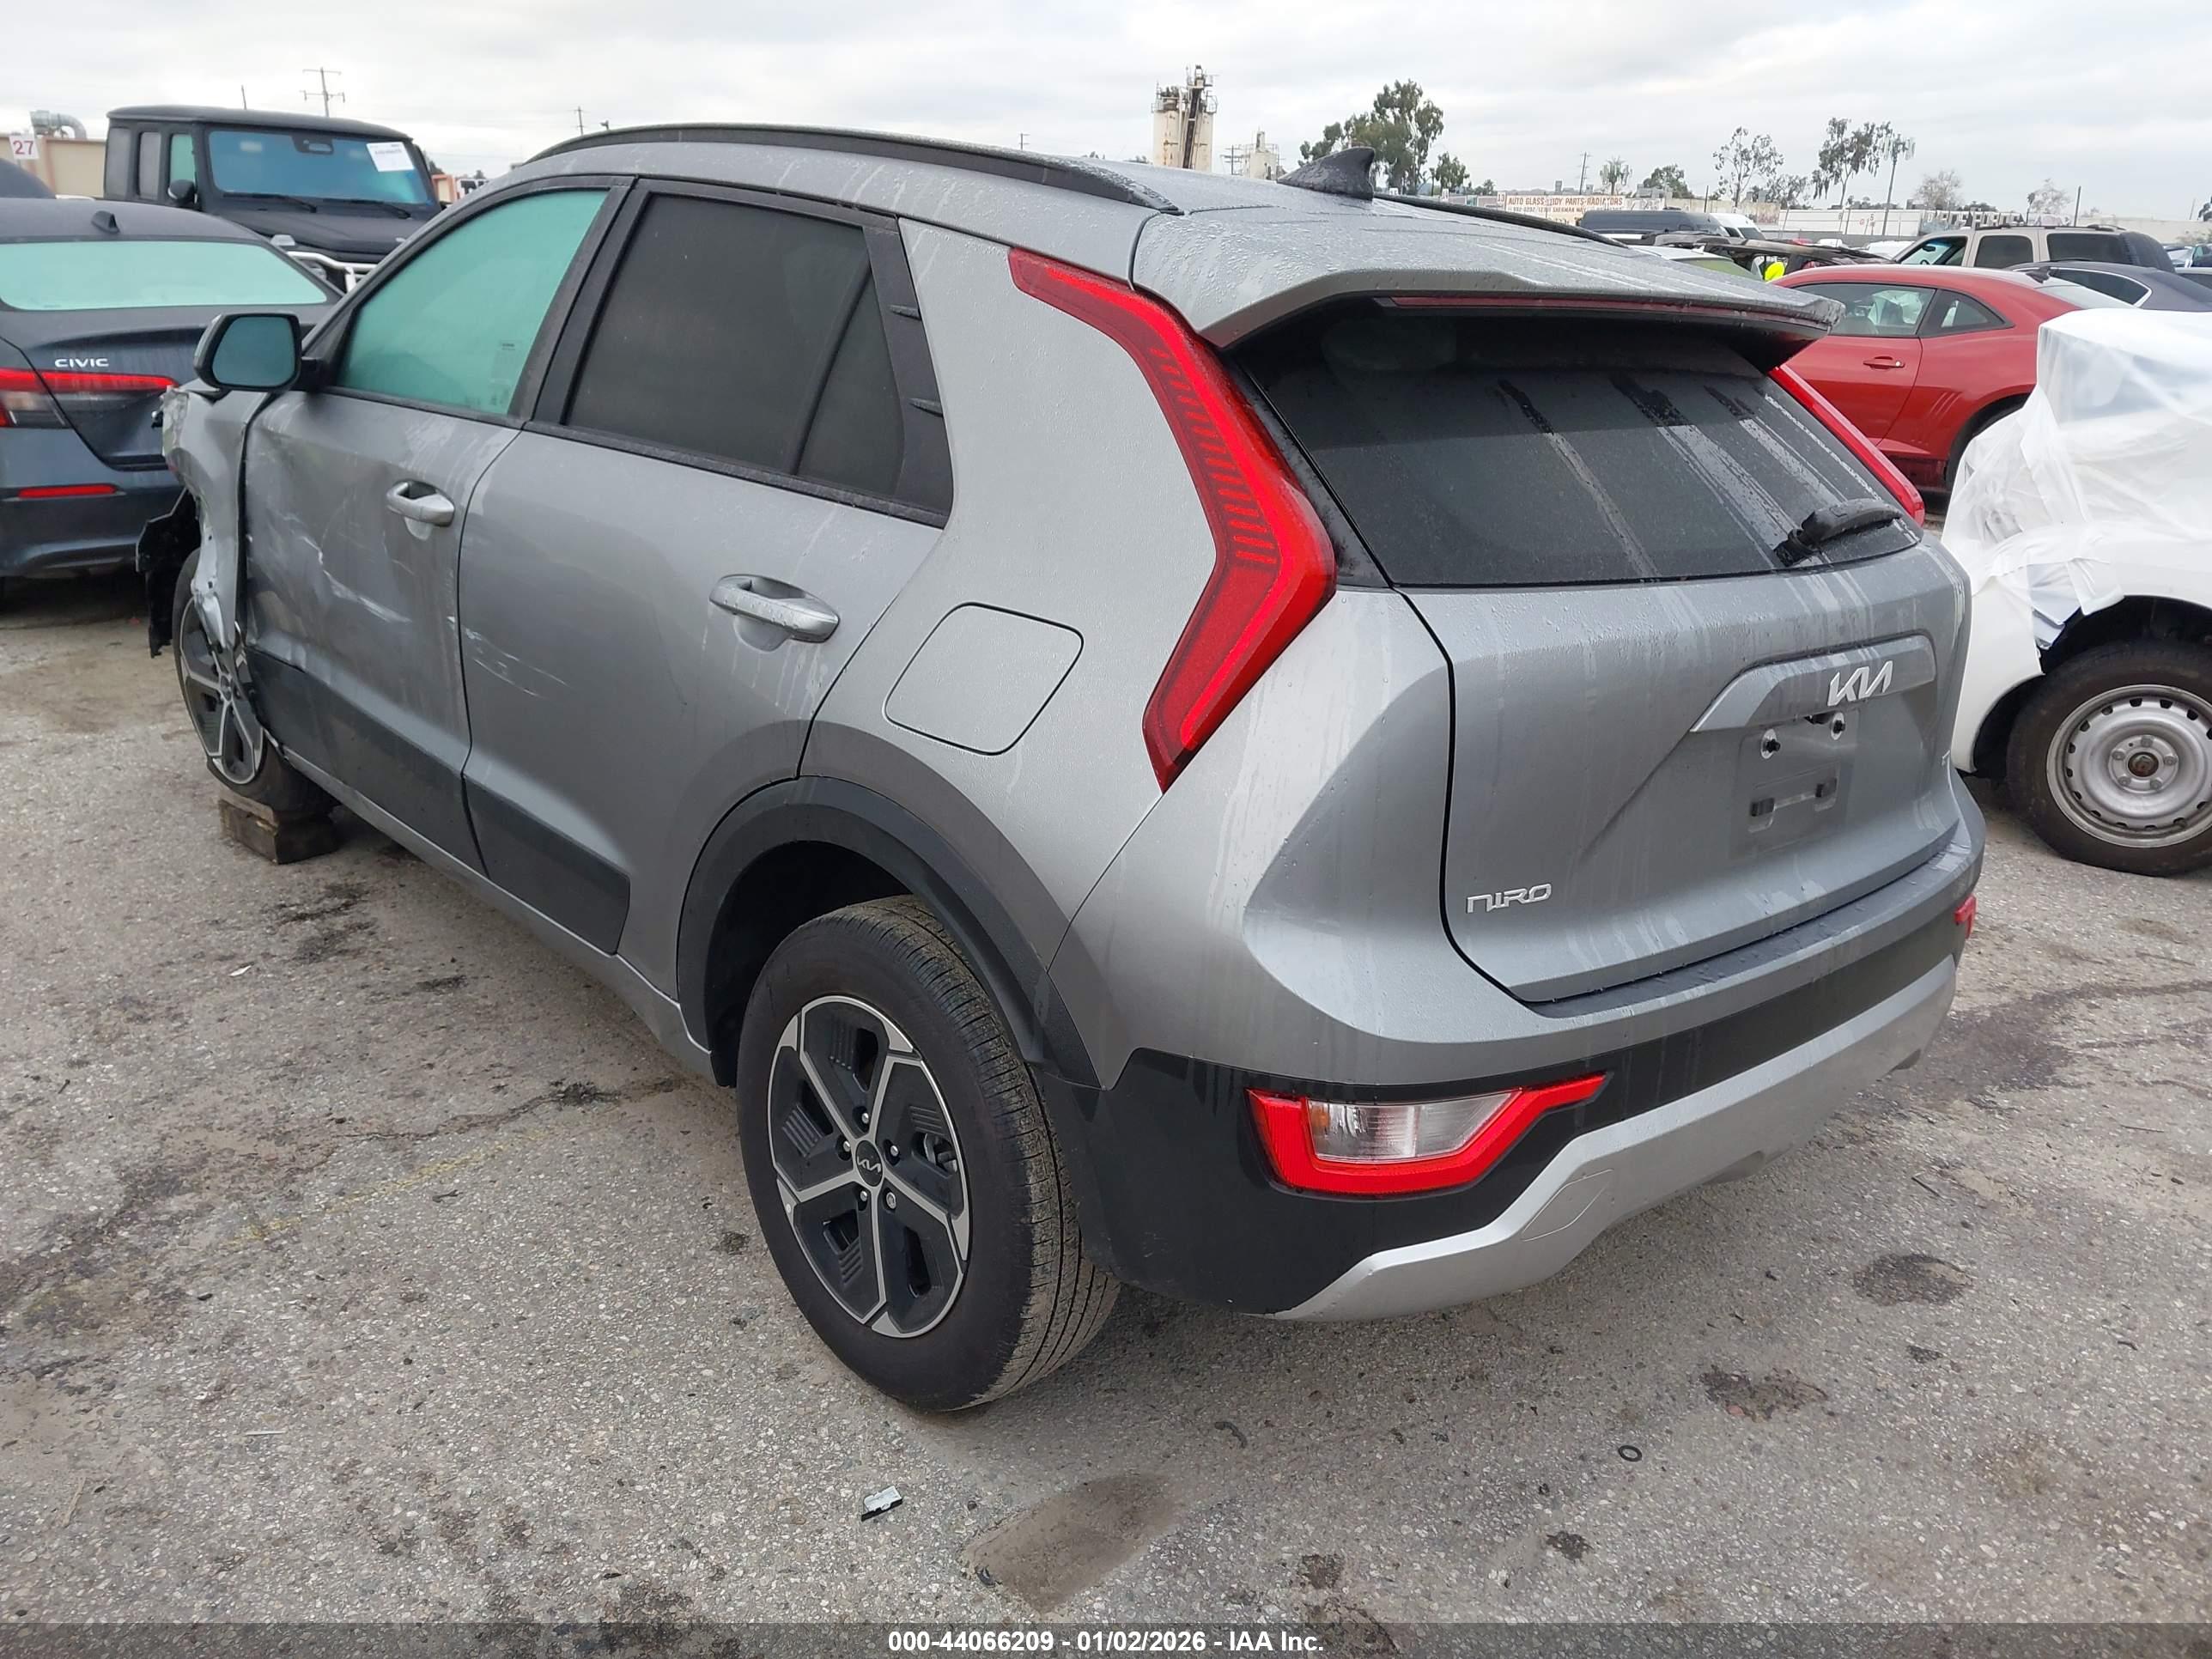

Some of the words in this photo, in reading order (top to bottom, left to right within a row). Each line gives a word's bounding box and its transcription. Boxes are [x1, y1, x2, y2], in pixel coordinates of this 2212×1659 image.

[13, 140, 33, 155] 27
[1509, 197, 1523, 205] AUTO
[54, 358, 109, 368] CIVIC
[1827, 660, 1893, 706] KIA
[1467, 883, 1552, 914] NIRO
[857, 1156, 882, 1173] KIA
